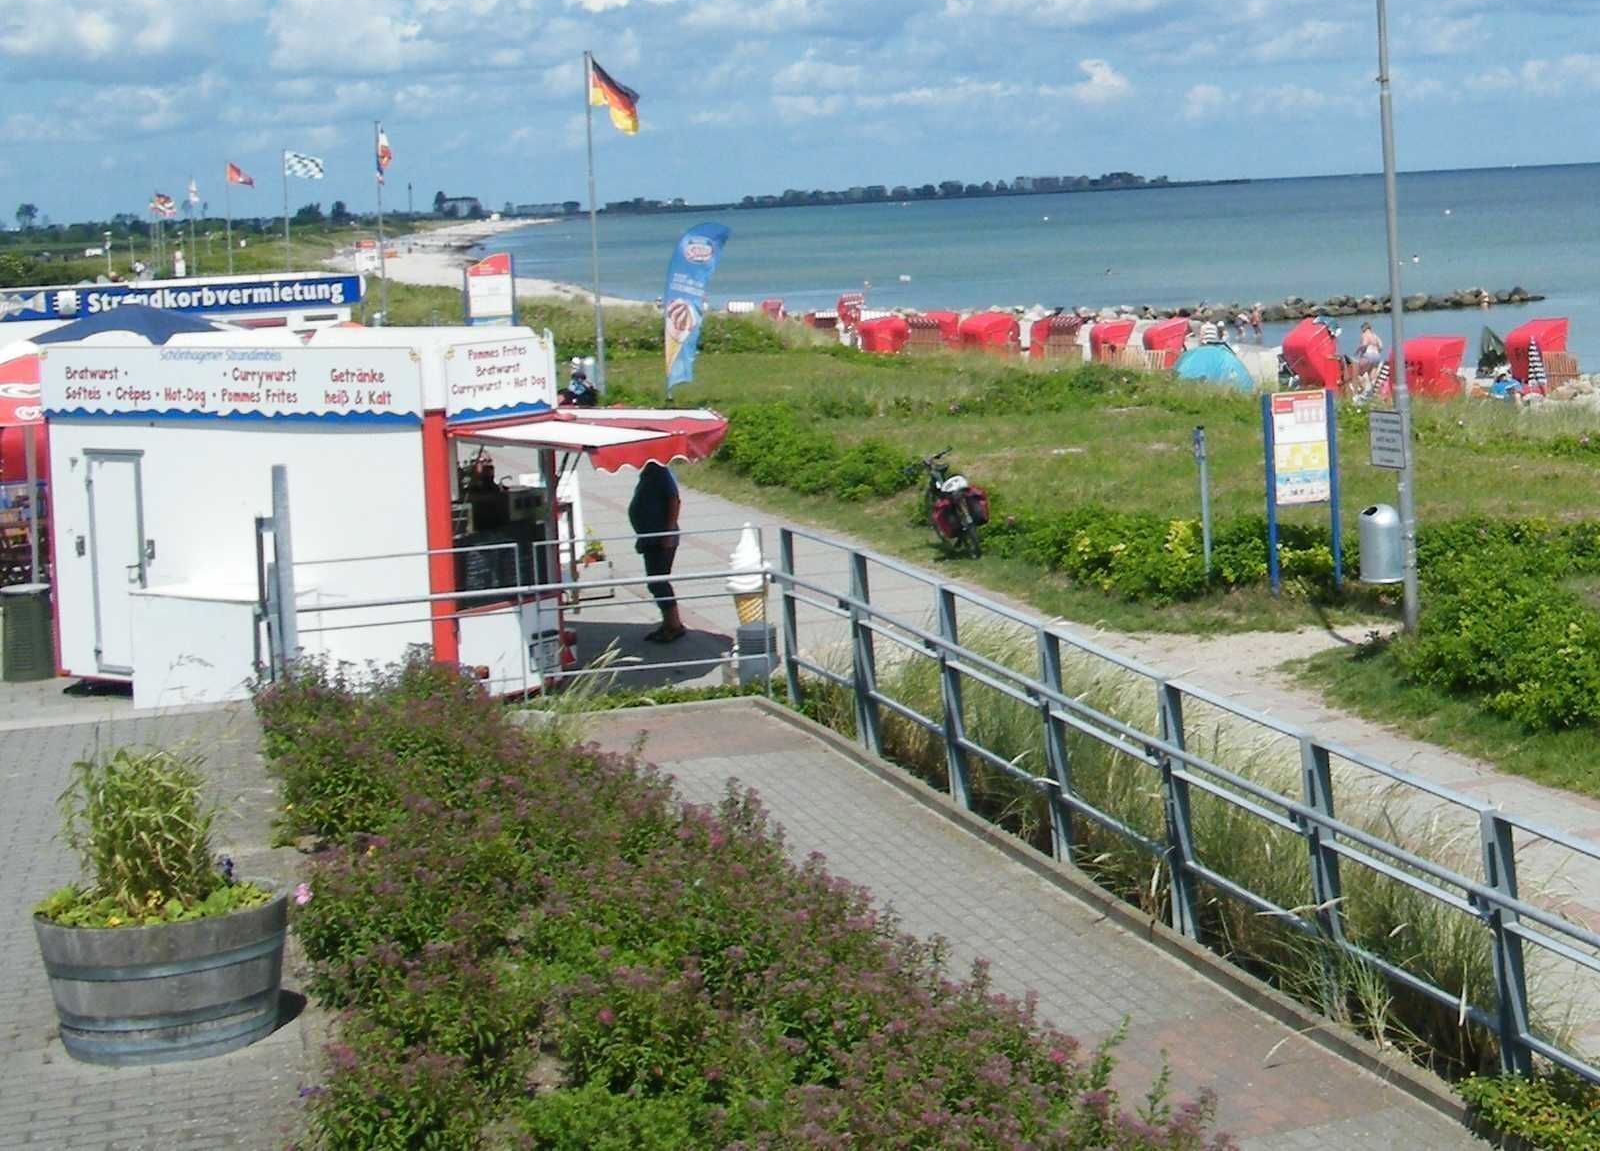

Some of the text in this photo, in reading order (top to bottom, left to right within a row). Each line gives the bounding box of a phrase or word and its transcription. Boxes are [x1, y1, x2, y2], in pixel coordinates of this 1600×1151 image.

[502, 345, 527, 358] Frites
[65, 366, 119, 380] Bratwurst
[232, 367, 297, 388] Currywurst
[330, 367, 385, 383] Getränke
[476, 362, 520, 377] Bratwurst
[451, 380, 503, 398] Currywurst
[531, 375, 546, 390] Dog
[65, 385, 298, 408] Softeis Crêpes Hot-Dog Pommes Frites
[324, 389, 349, 406] heiß
